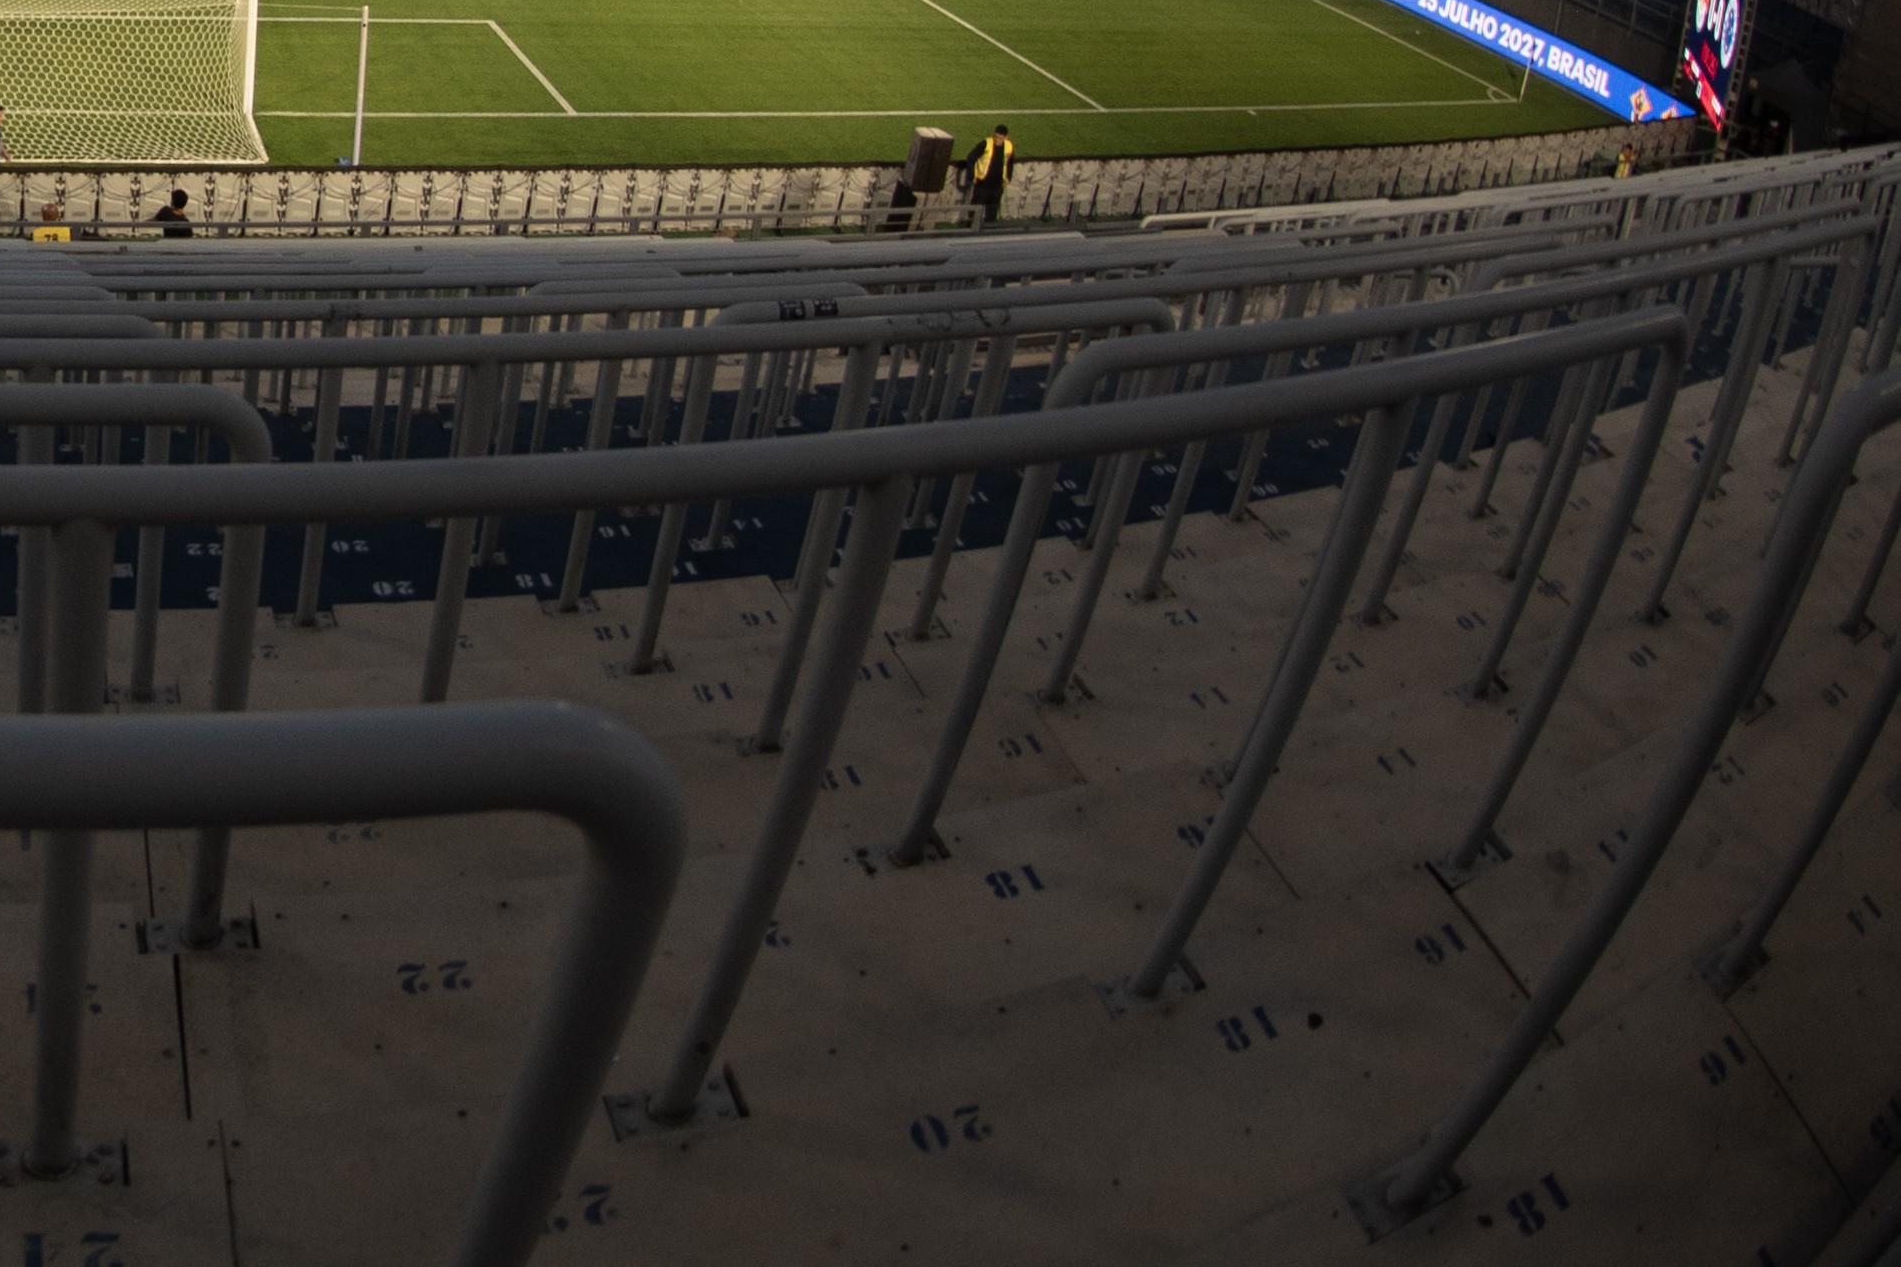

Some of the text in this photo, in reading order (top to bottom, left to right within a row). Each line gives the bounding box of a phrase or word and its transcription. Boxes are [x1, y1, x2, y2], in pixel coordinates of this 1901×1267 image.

[1498, 23, 1545, 67] 2027,
[1547, 45, 1610, 98] BRASIL
[598, 524, 631, 539] 16
[186, 542, 222, 556] 22
[331, 540, 368, 553] 20
[372, 580, 414, 595] 20
[515, 573, 553, 588] 18
[1164, 609, 1198, 626] 12
[594, 624, 630, 640] 18
[693, 682, 733, 703] 18
[998, 734, 1043, 758] 16
[986, 864, 1045, 899] 18
[1414, 923, 1467, 964] 16
[397, 961, 472, 994] 22
[1215, 1005, 1279, 1053] 18
[1700, 1034, 1747, 1086] 16
[910, 1104, 993, 1152] 20
[1506, 1172, 1571, 1237] 18
